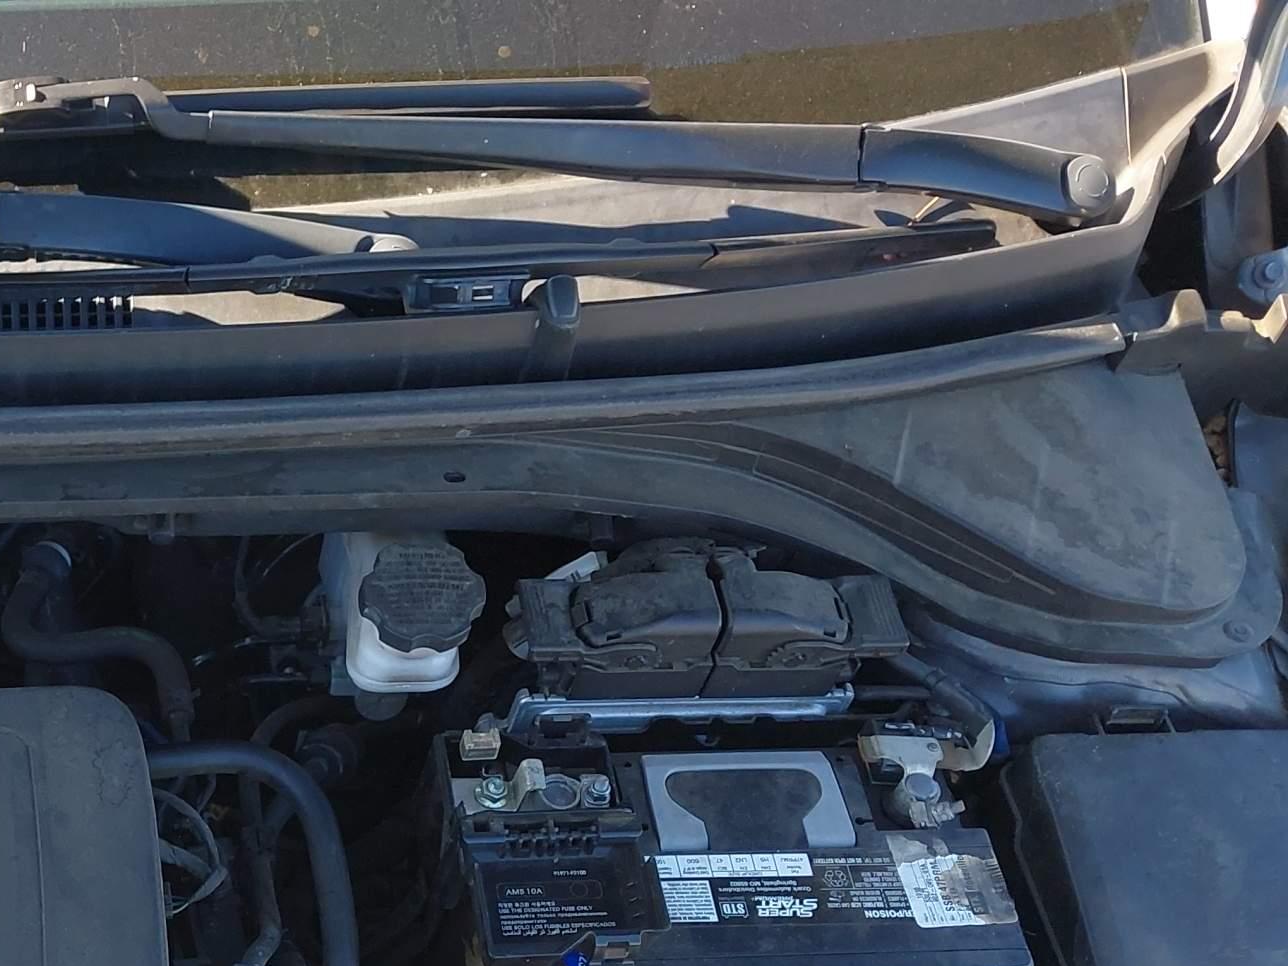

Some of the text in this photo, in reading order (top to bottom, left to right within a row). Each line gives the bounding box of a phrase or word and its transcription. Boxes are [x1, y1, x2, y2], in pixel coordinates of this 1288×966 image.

[723, 903, 745, 914] STD
[756, 898, 818, 910] START
[942, 895, 954, 912] SSB
[757, 908, 813, 918] SUPER
[864, 909, 914, 918] R/POISON
